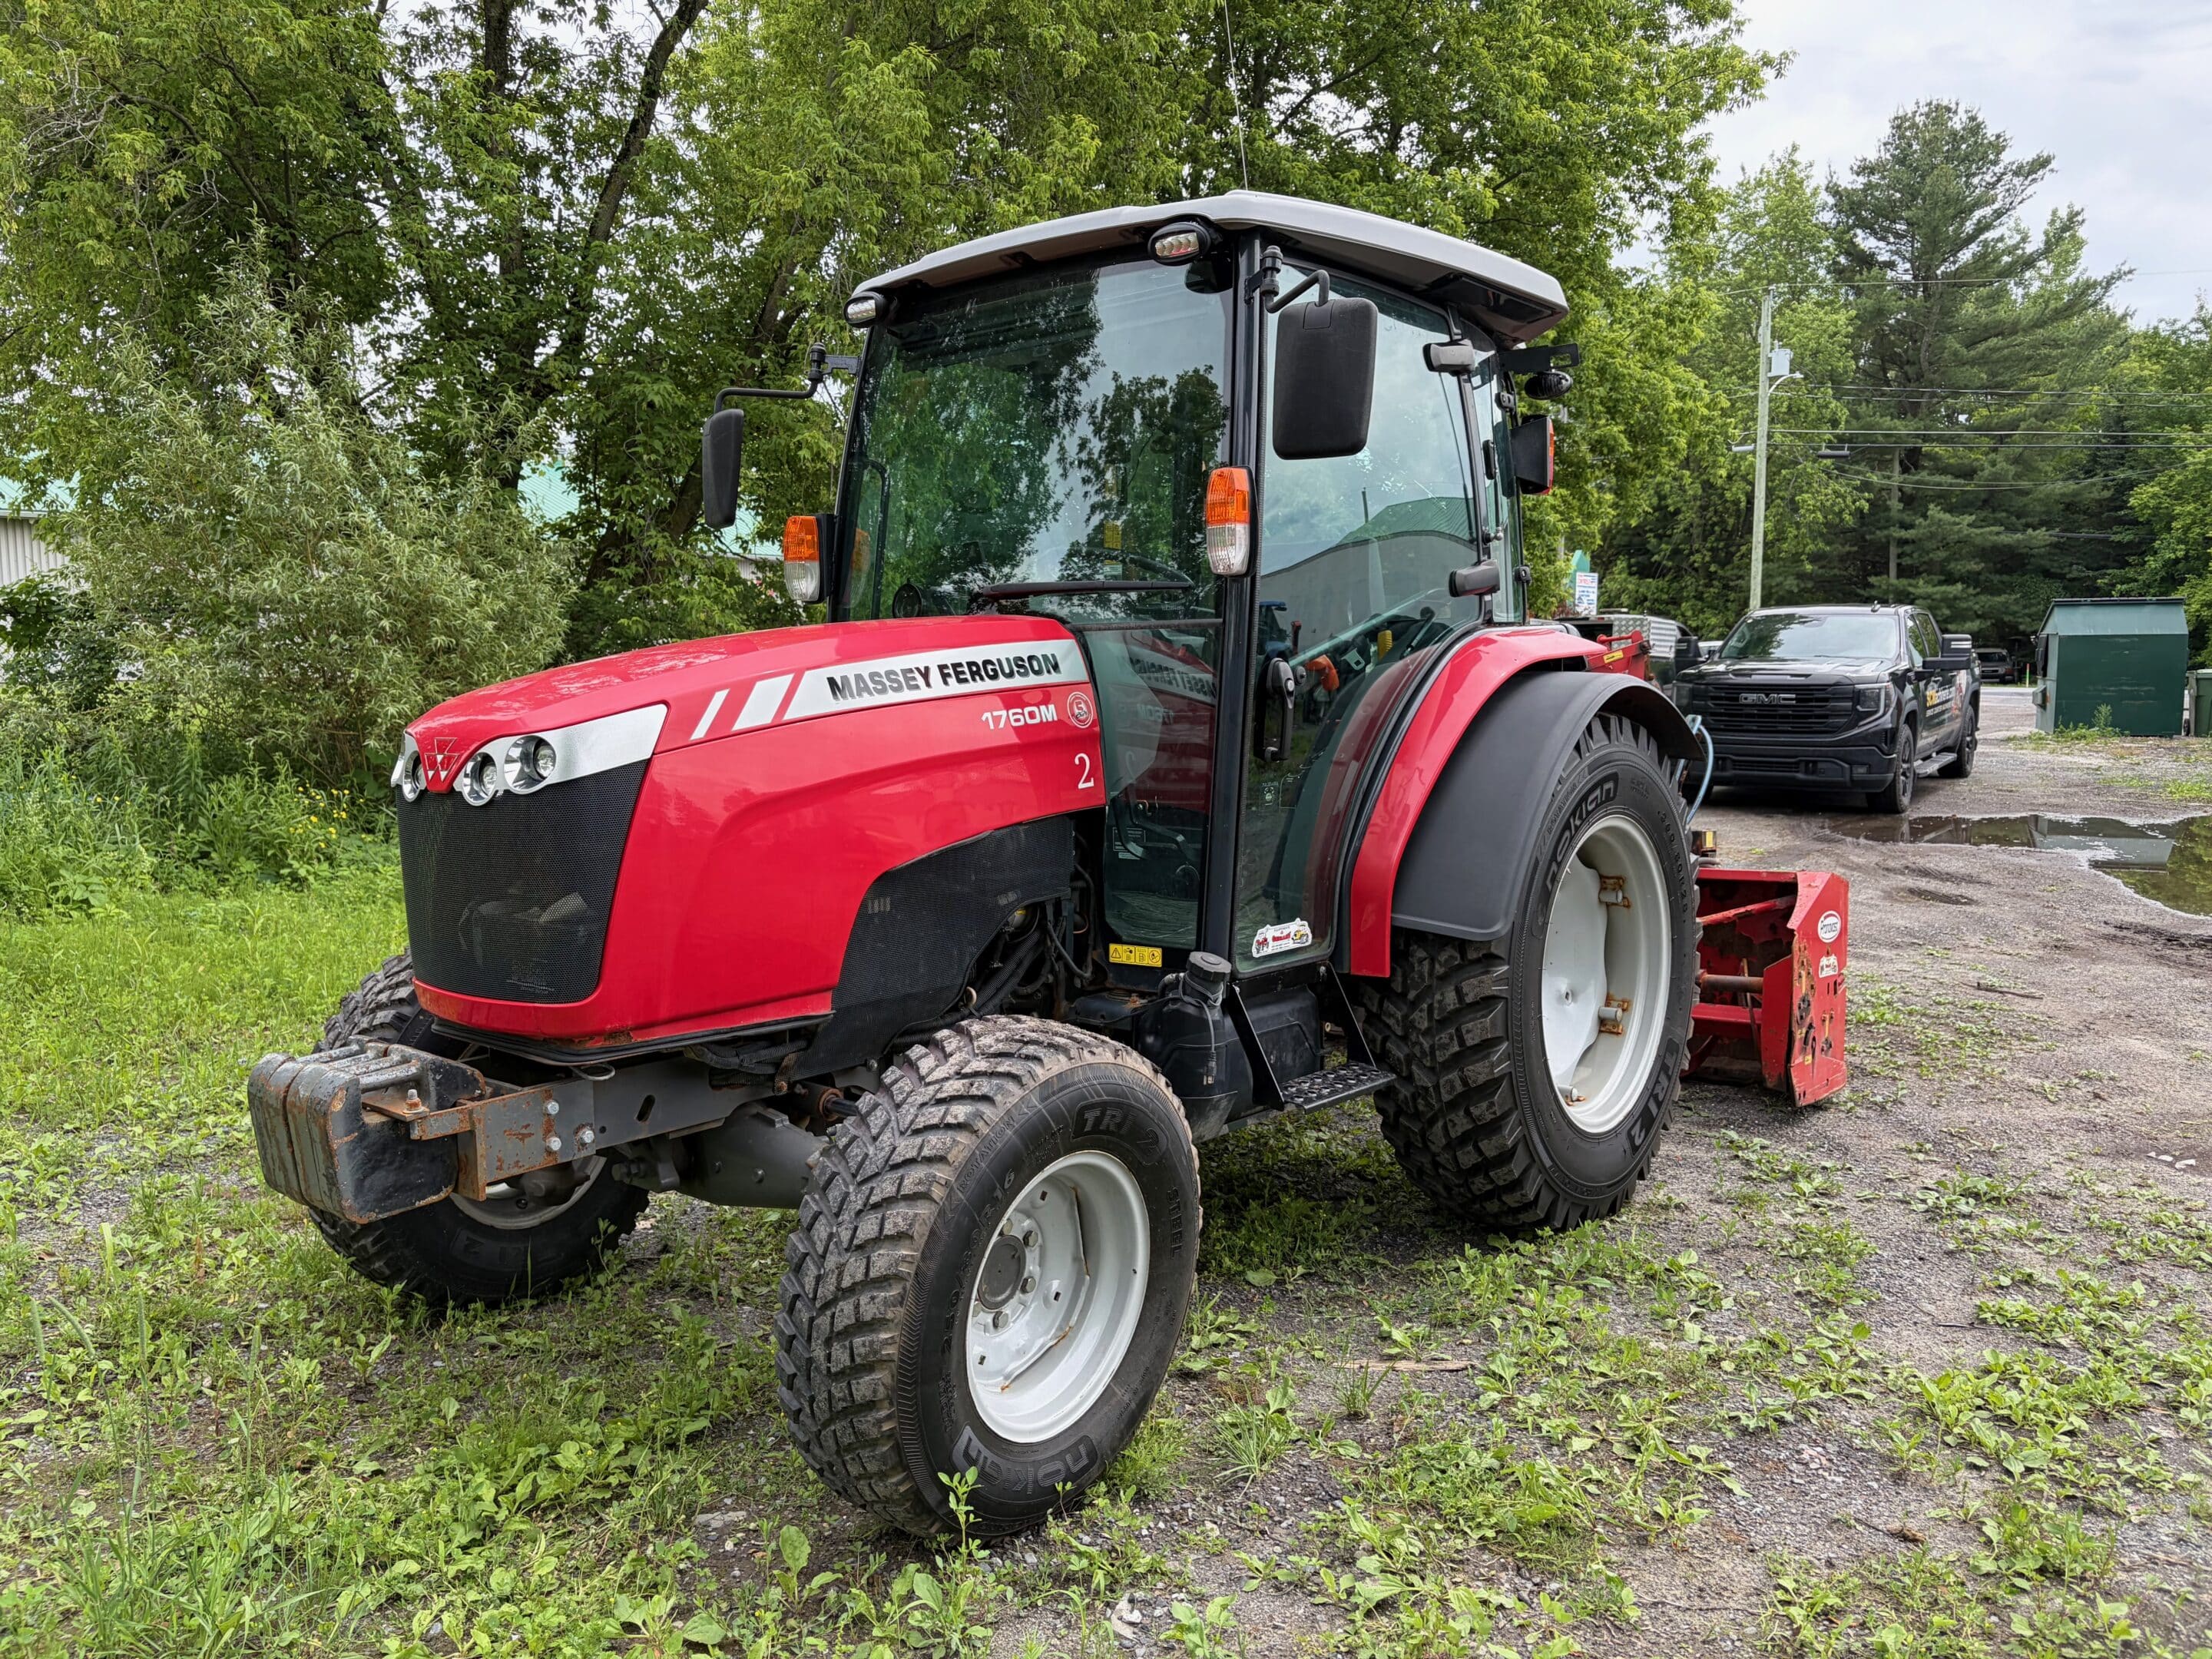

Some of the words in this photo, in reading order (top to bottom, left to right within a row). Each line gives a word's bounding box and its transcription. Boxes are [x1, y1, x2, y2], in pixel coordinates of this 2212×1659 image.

[826, 665, 932, 702] MASSEY
[937, 653, 1062, 687] FERGUSON
[1739, 693, 1796, 705] GMC
[981, 704, 1058, 730] 1760M
[1074, 753, 1095, 790] 2
[1647, 1050, 1677, 1119] TRI
[1083, 1106, 1137, 1133] TRI
[1630, 1116, 1646, 1147] 2
[956, 1115, 1015, 1194] ROTATION
[1167, 1185, 1183, 1260] STEEL
[962, 1435, 1090, 1495] nokian
